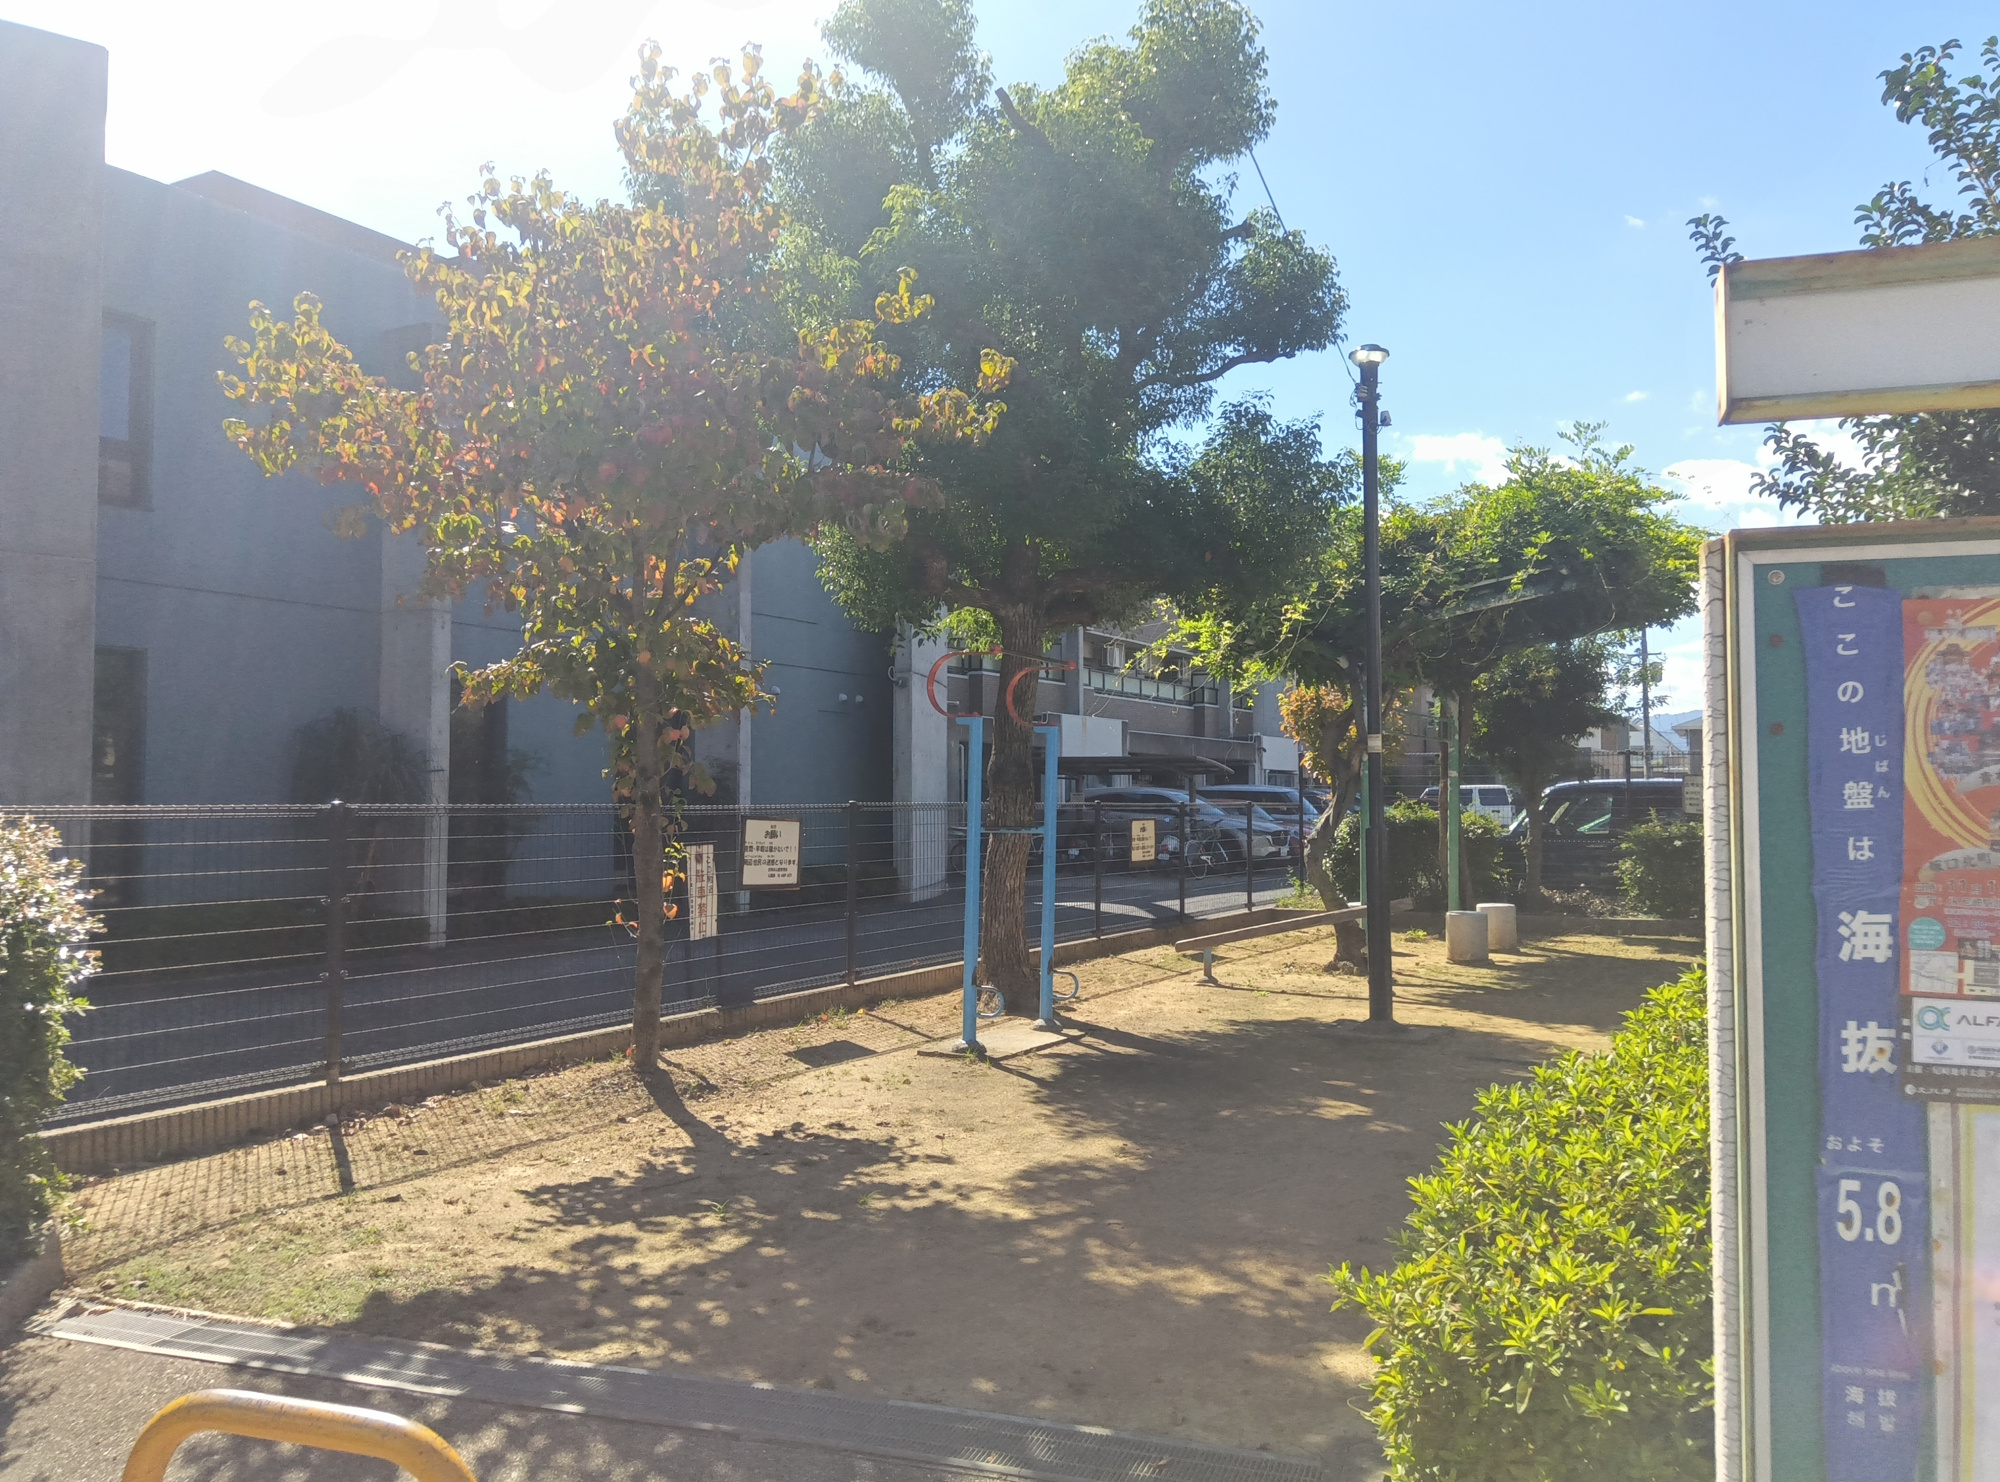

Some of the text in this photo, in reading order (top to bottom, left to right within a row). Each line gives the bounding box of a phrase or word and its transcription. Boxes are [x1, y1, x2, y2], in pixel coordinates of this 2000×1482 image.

[1833, 585, 1875, 861] ここの地盤は
[1874, 734, 1891, 798] じばん
[1837, 910, 1897, 1074] 海抜
[1826, 1134, 1885, 1154] およそ
[1836, 1179, 1902, 1245] 5.8
